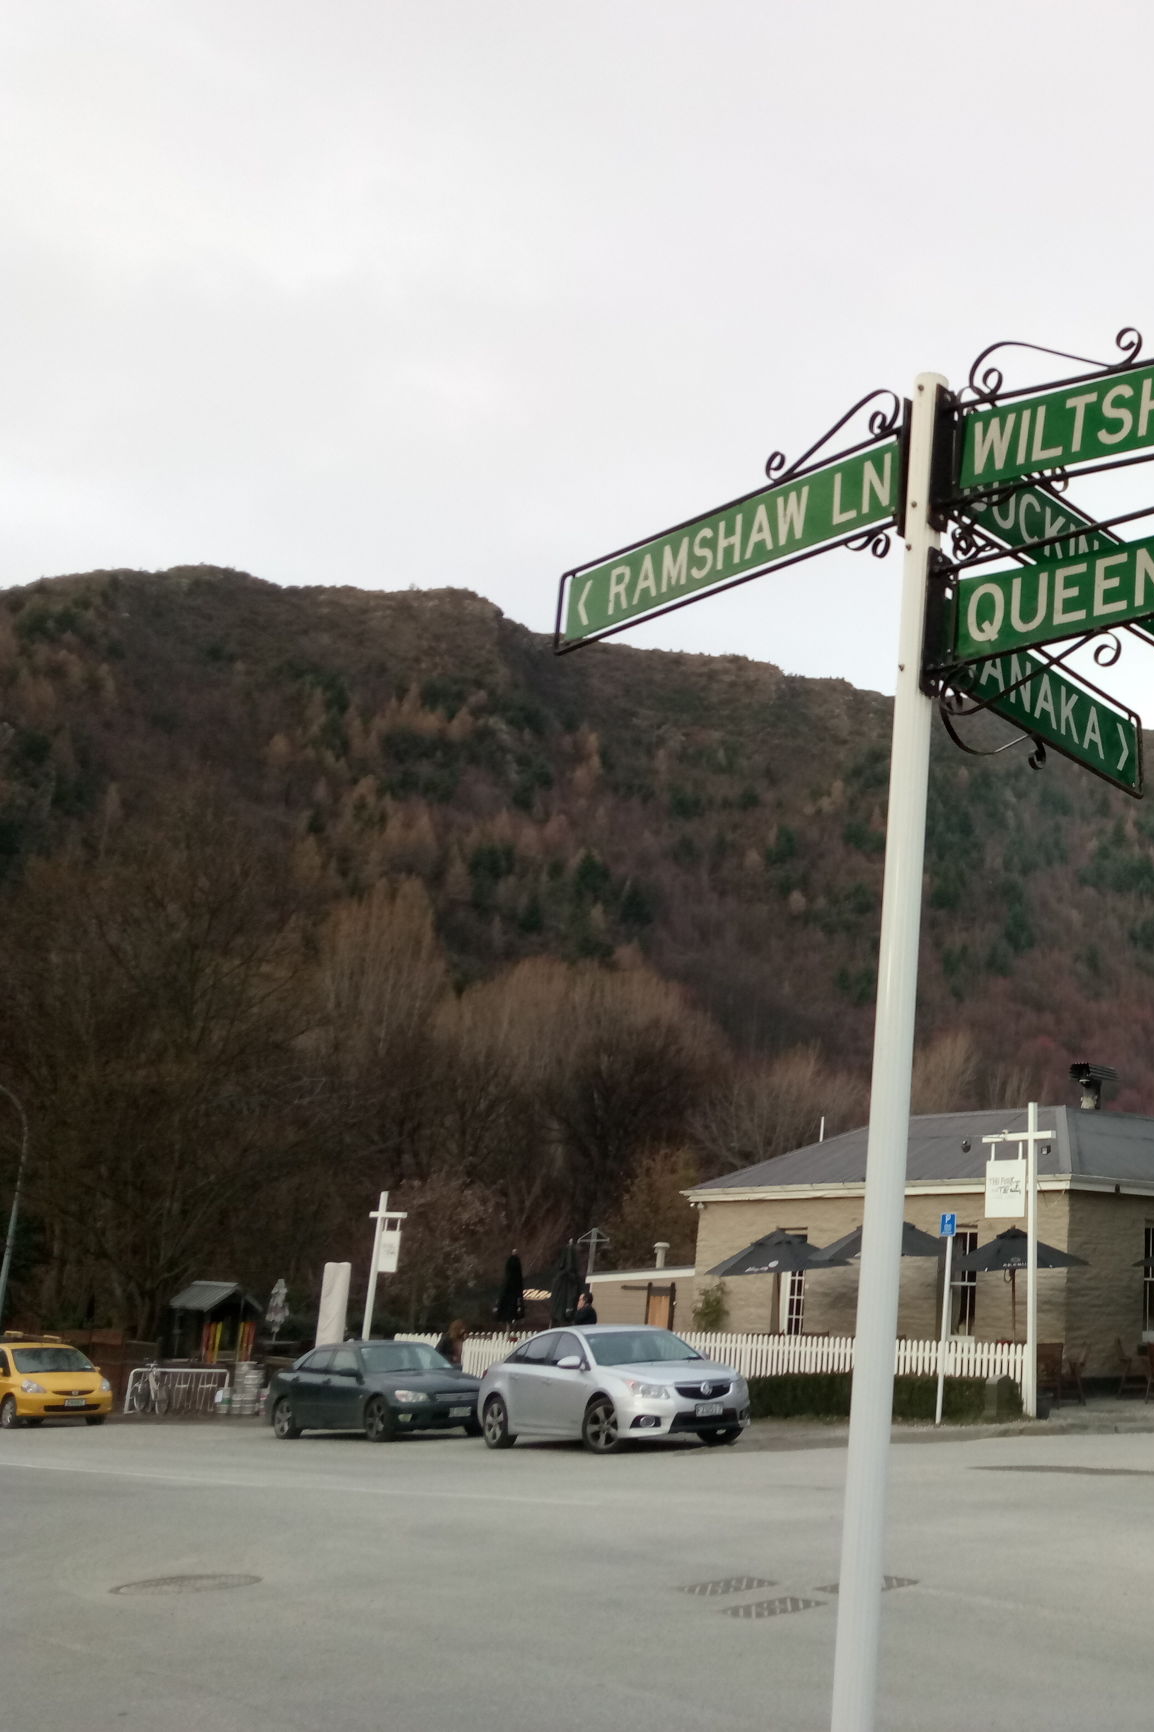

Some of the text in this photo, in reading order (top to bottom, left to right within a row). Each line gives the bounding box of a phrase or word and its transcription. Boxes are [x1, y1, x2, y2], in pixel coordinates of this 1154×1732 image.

[607, 452, 893, 616] RAMSHAW LN
[968, 653, 1105, 760] ANAKA
